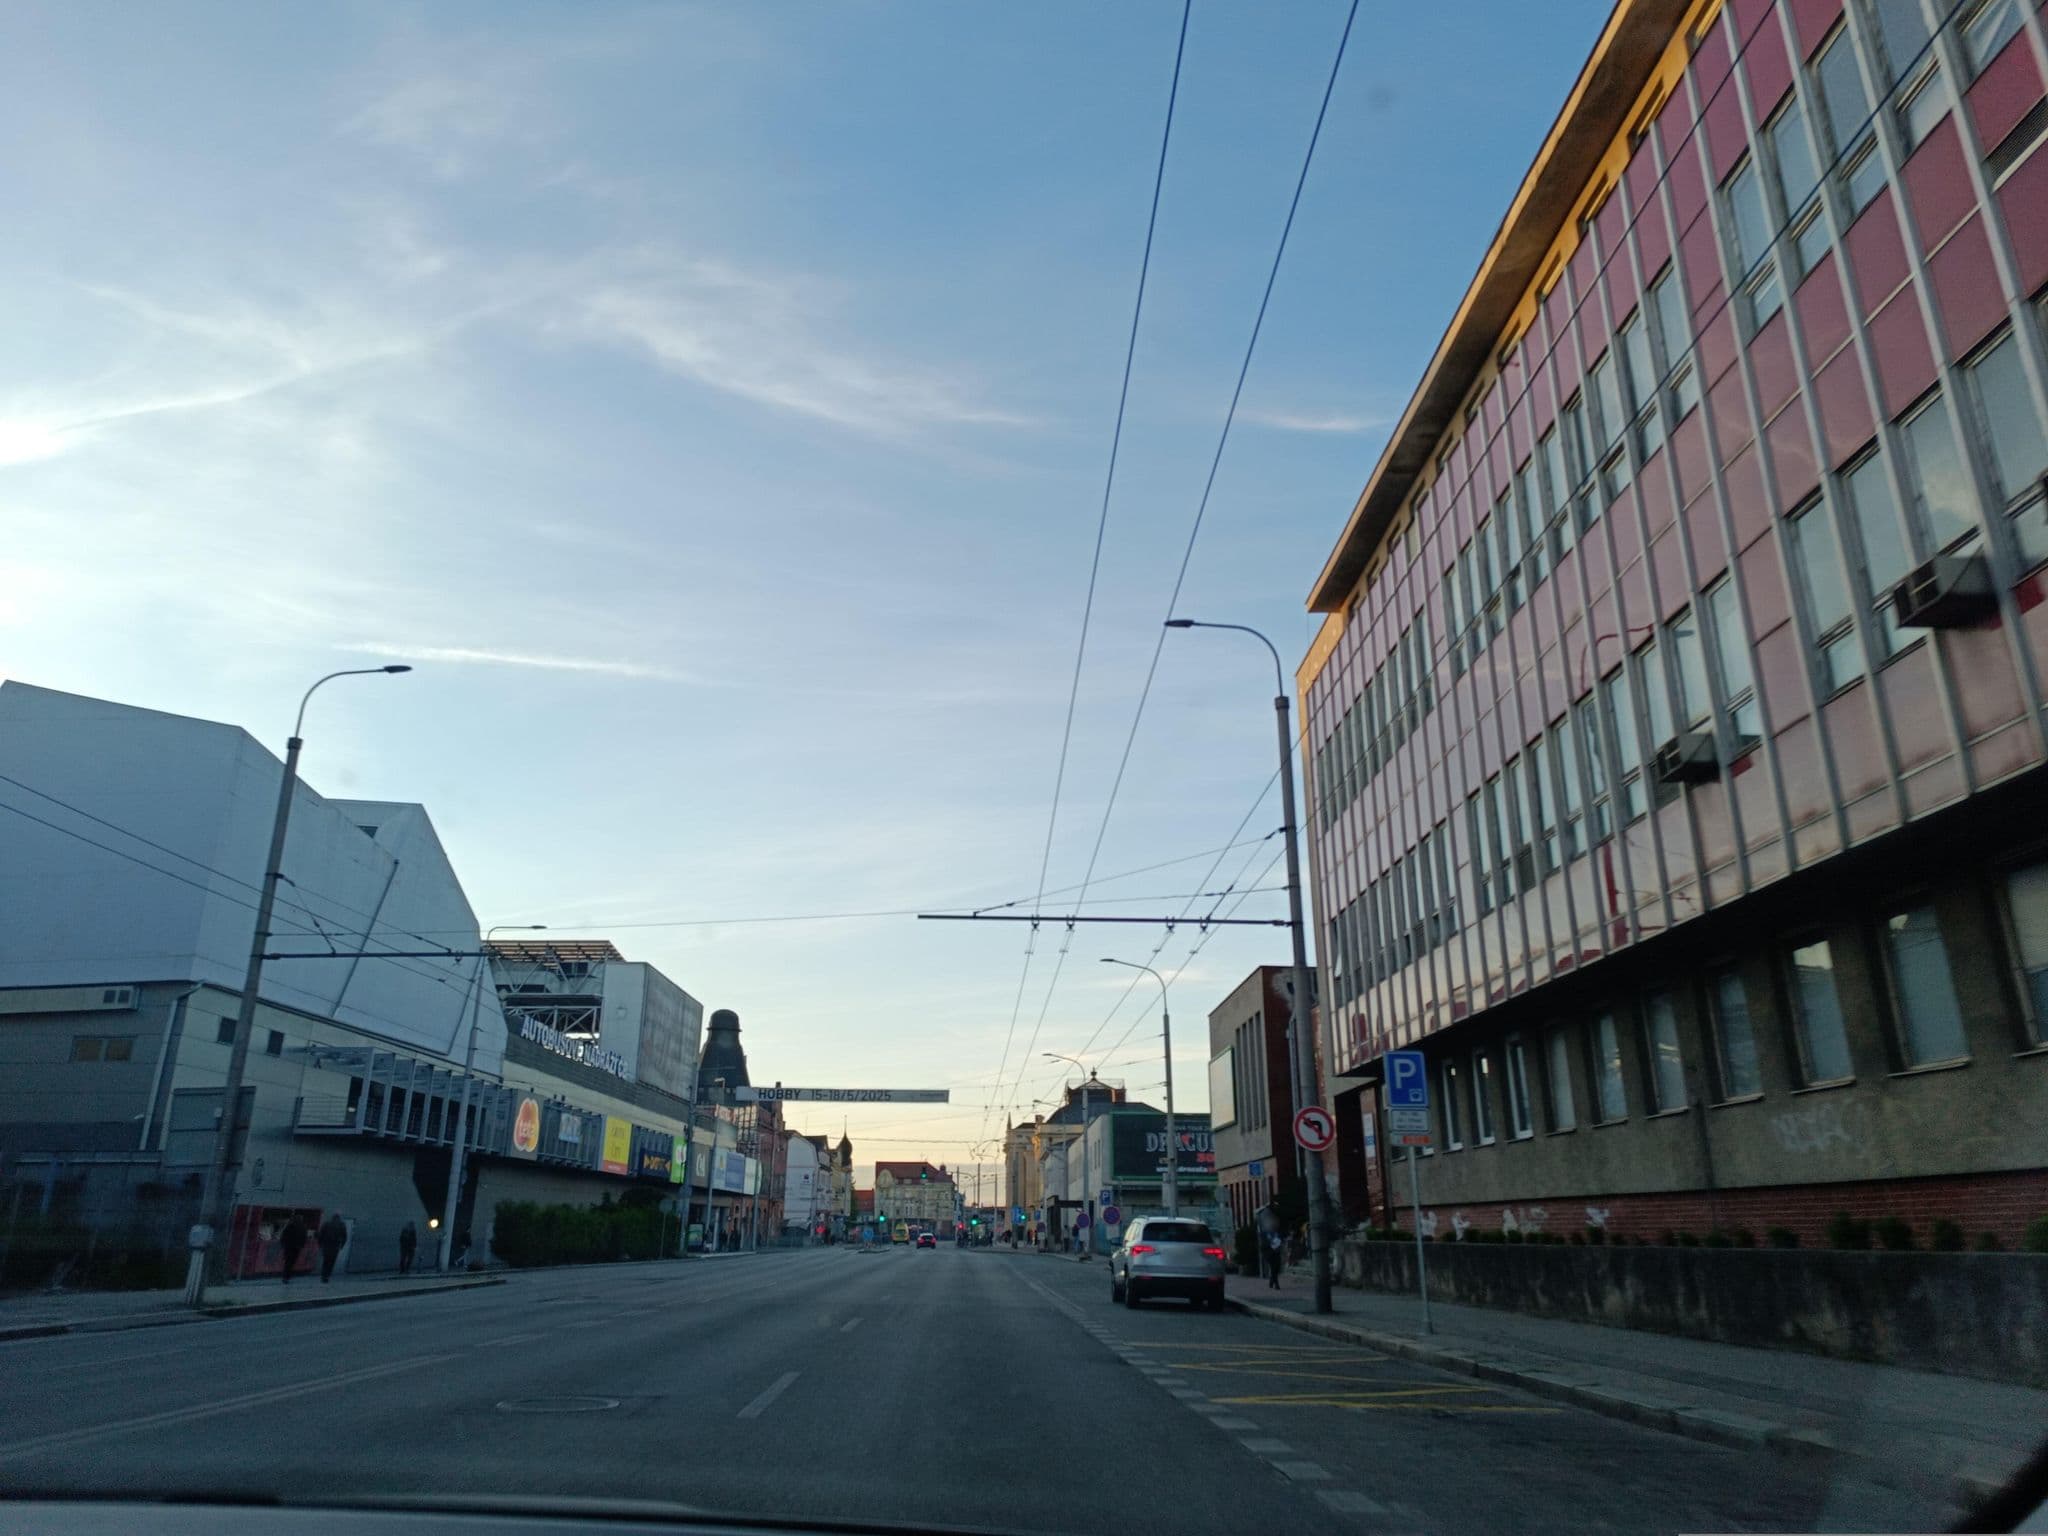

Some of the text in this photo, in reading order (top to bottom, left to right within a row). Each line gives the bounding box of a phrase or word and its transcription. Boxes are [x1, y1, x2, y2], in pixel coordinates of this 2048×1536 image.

[520, 1015, 583, 1062] AUTOBUSOVÉ
[1394, 1058, 1416, 1089] P
[758, 1089, 892, 1101] HOBBY 15-18/5/2025
